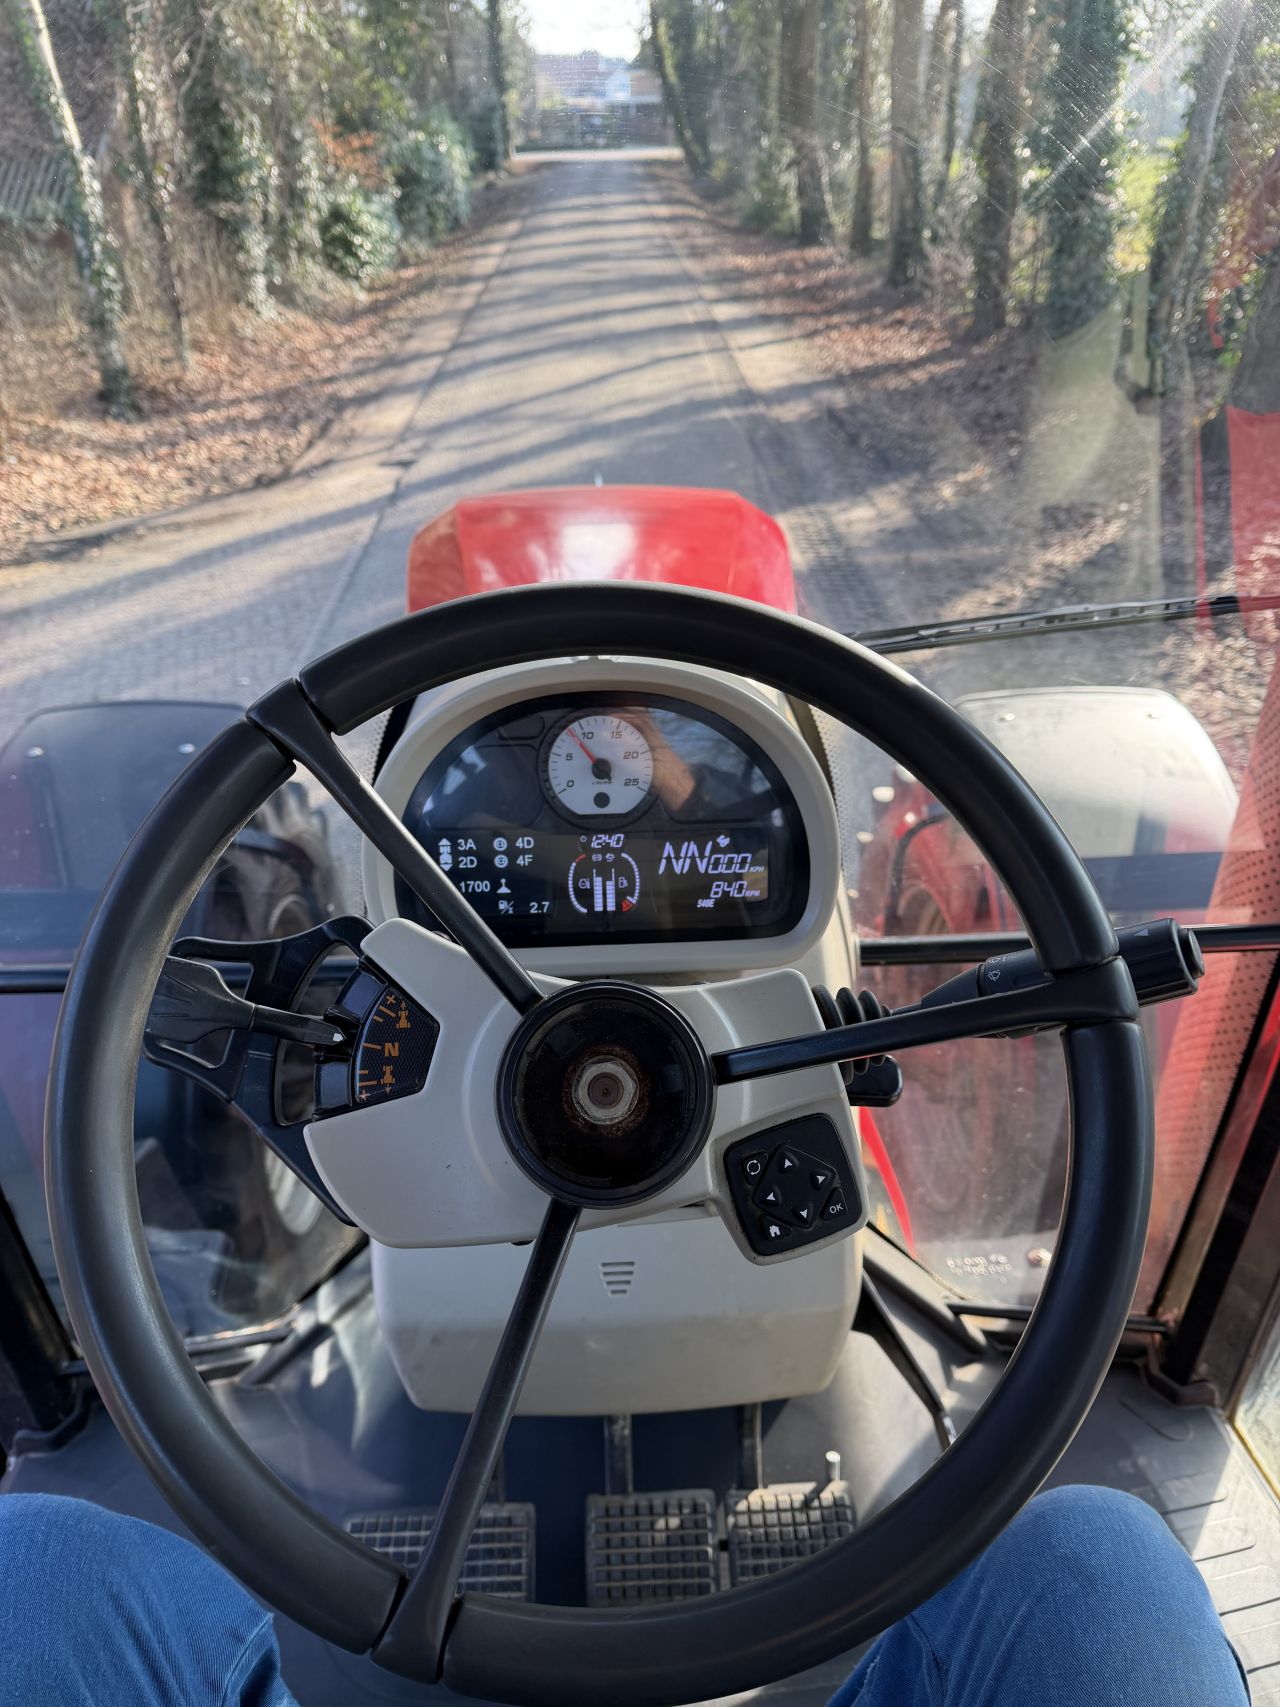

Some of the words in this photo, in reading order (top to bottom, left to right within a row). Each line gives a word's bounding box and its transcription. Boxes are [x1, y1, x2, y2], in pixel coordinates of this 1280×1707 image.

[581, 731, 594, 740] 10
[610, 731, 622, 739] 15
[565, 752, 573, 761] 5
[623, 751, 639, 760] 20
[566, 779, 574, 788] 0
[624, 778, 639, 787] 25
[457, 838, 477, 850] 3A
[515, 836, 535, 849] 4D
[591, 834, 624, 848] 12:40
[458, 856, 478, 869] 2D
[516, 854, 533, 867] 4F
[707, 853, 752, 874] 000
[459, 880, 491, 893] 1700
[710, 881, 748, 898] 840
[529, 901, 550, 914] 2.7
[384, 1042, 399, 1057] N
[829, 1202, 844, 1214] OK
